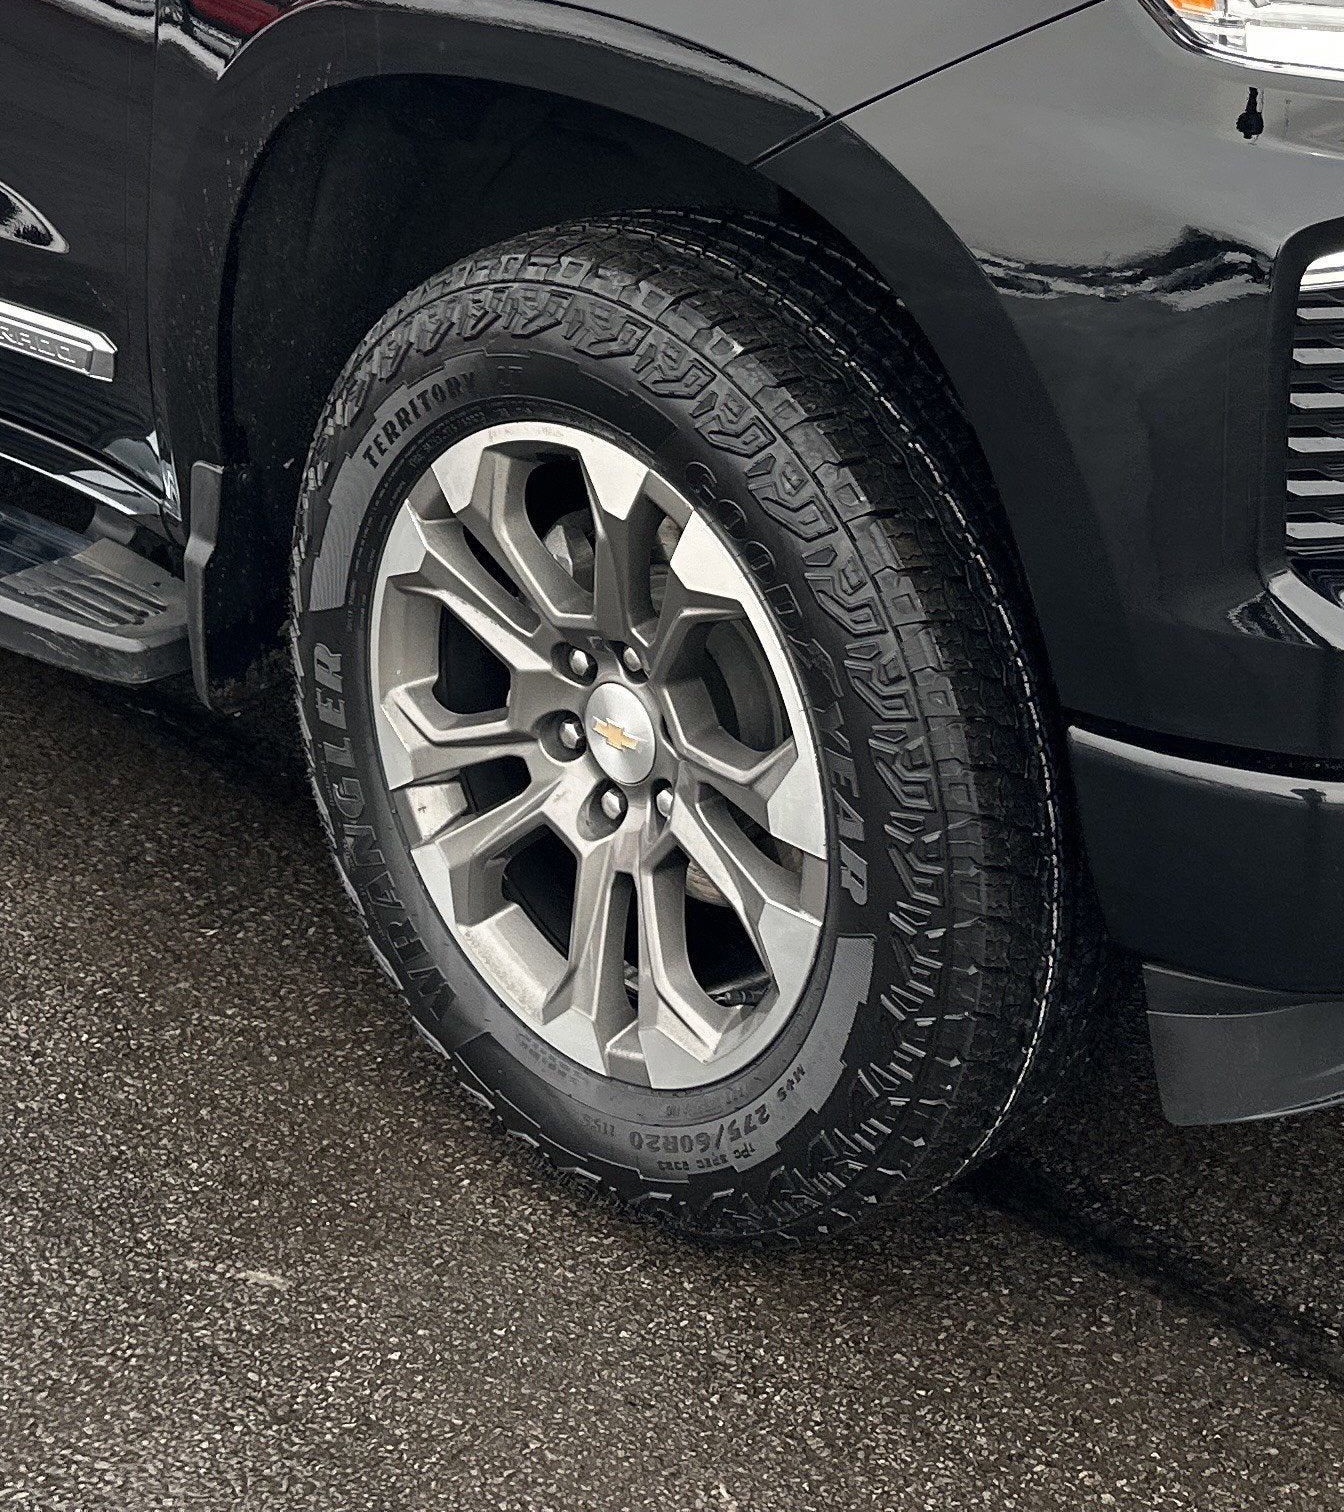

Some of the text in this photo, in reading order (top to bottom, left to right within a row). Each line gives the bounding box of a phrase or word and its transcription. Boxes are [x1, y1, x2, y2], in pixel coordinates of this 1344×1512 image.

[361, 370, 477, 470] TERRITORY
[683, 460, 869, 906] GOODYEAR
[313, 641, 454, 1022] WRANGLER
[629, 1102, 772, 1155] 275/60R20
